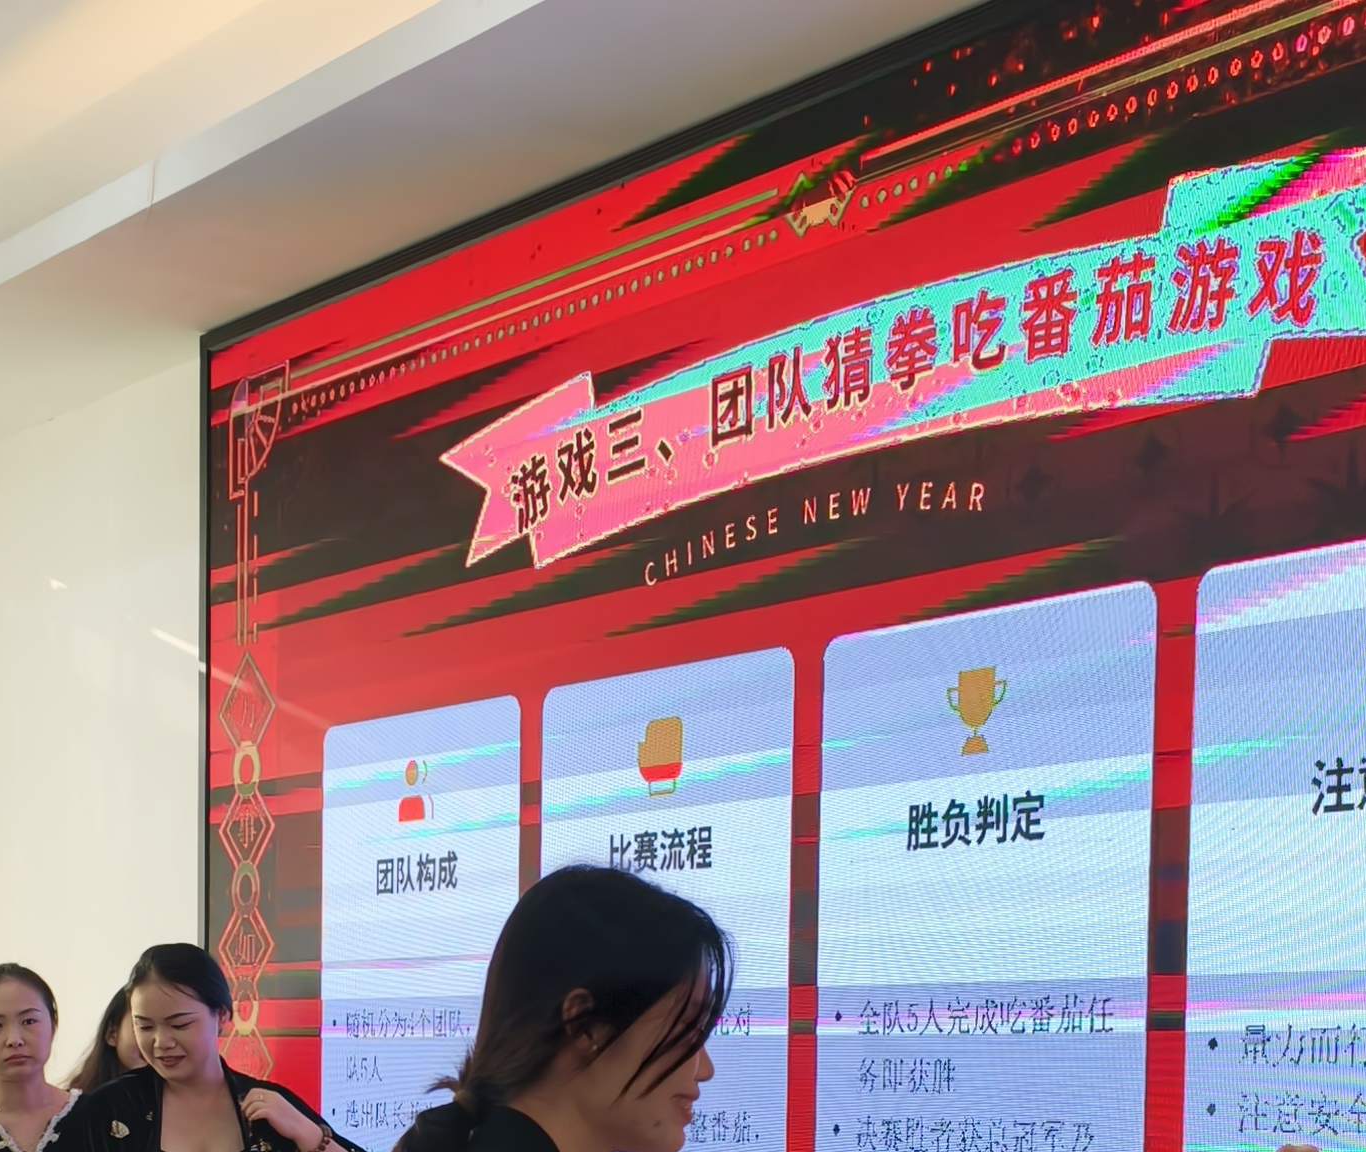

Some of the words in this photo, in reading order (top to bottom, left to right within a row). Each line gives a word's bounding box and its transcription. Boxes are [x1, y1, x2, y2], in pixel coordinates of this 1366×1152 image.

[507, 228, 1327, 536] 游戏三、团队猜拳吃番茄游戏
[644, 514, 781, 588] CHINESE
[802, 490, 872, 522] NEW
[896, 480, 988, 514] YEAR
[906, 790, 1046, 851] 胜负判定
[608, 825, 713, 873] 比赛流程
[375, 850, 459, 897] 团队构成
[858, 993, 1114, 1036] 全队5人完成吃番茄任
[858, 1057, 956, 1094] 务即获胜
